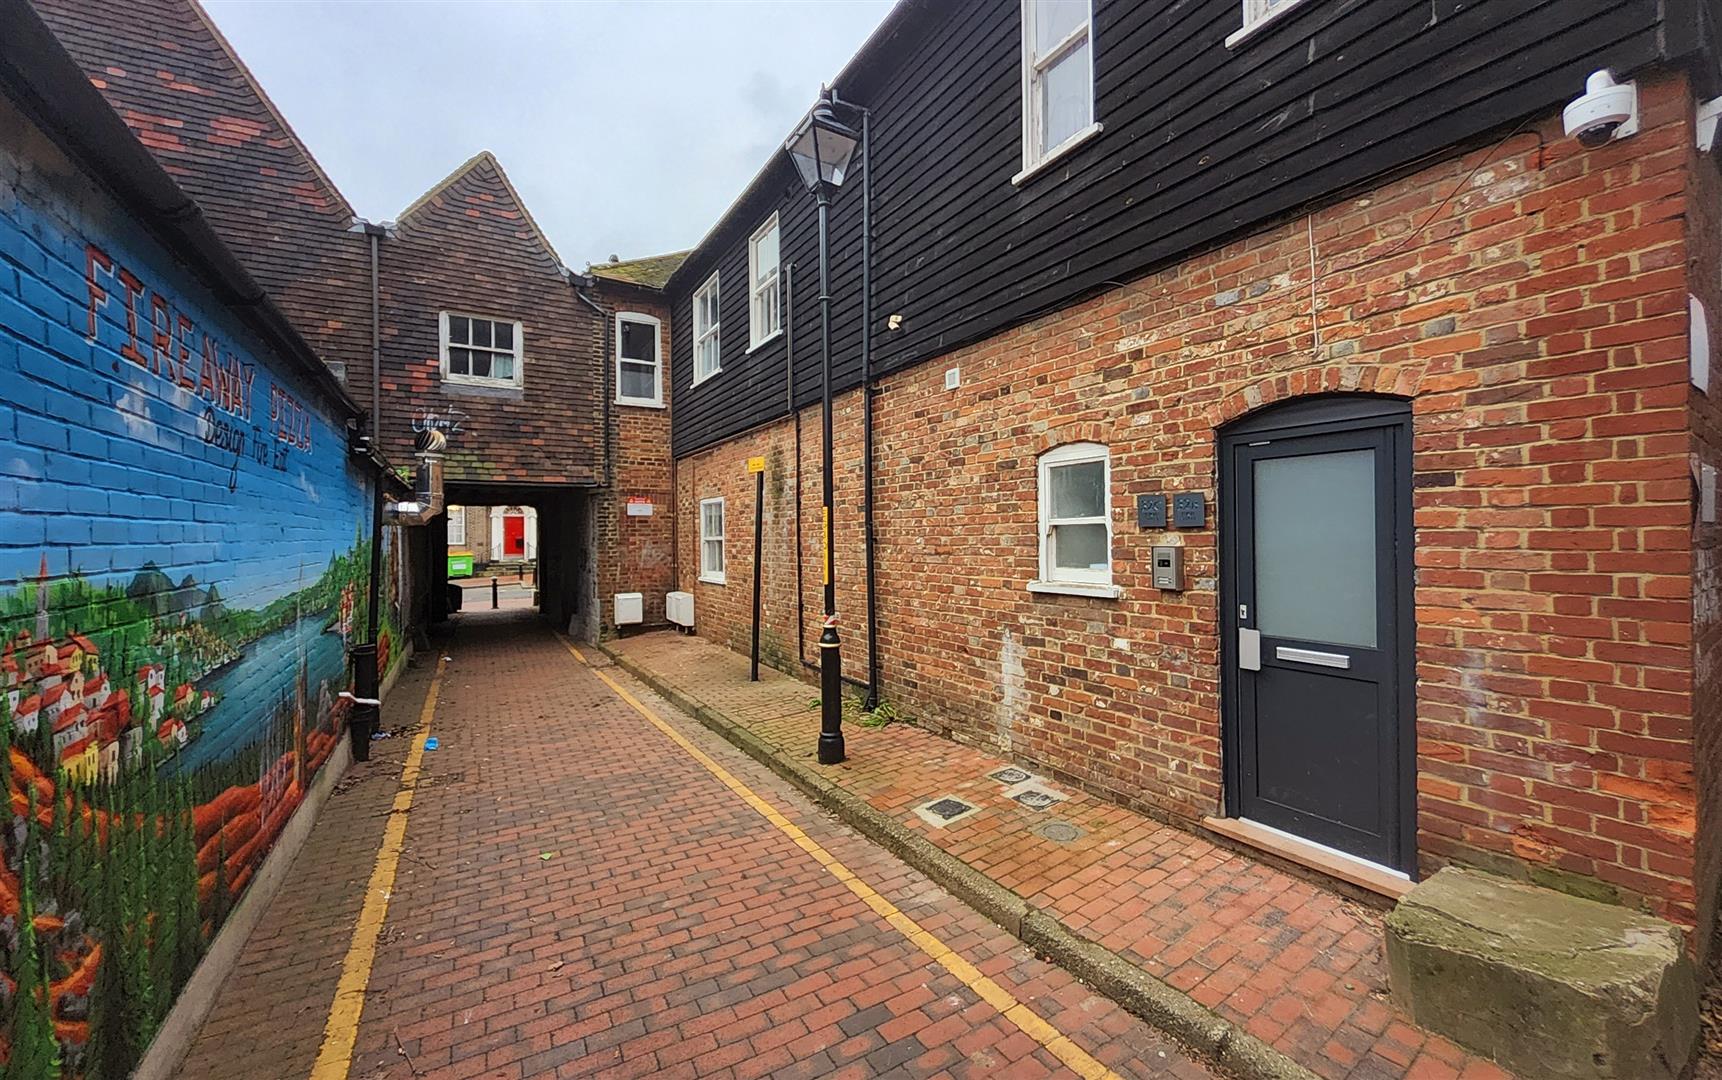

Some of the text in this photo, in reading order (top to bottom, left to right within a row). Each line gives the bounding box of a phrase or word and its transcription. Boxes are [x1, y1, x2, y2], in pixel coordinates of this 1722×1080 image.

[84, 244, 313, 455] FIREAWAY PIZZA
[204, 406, 245, 493] Design
